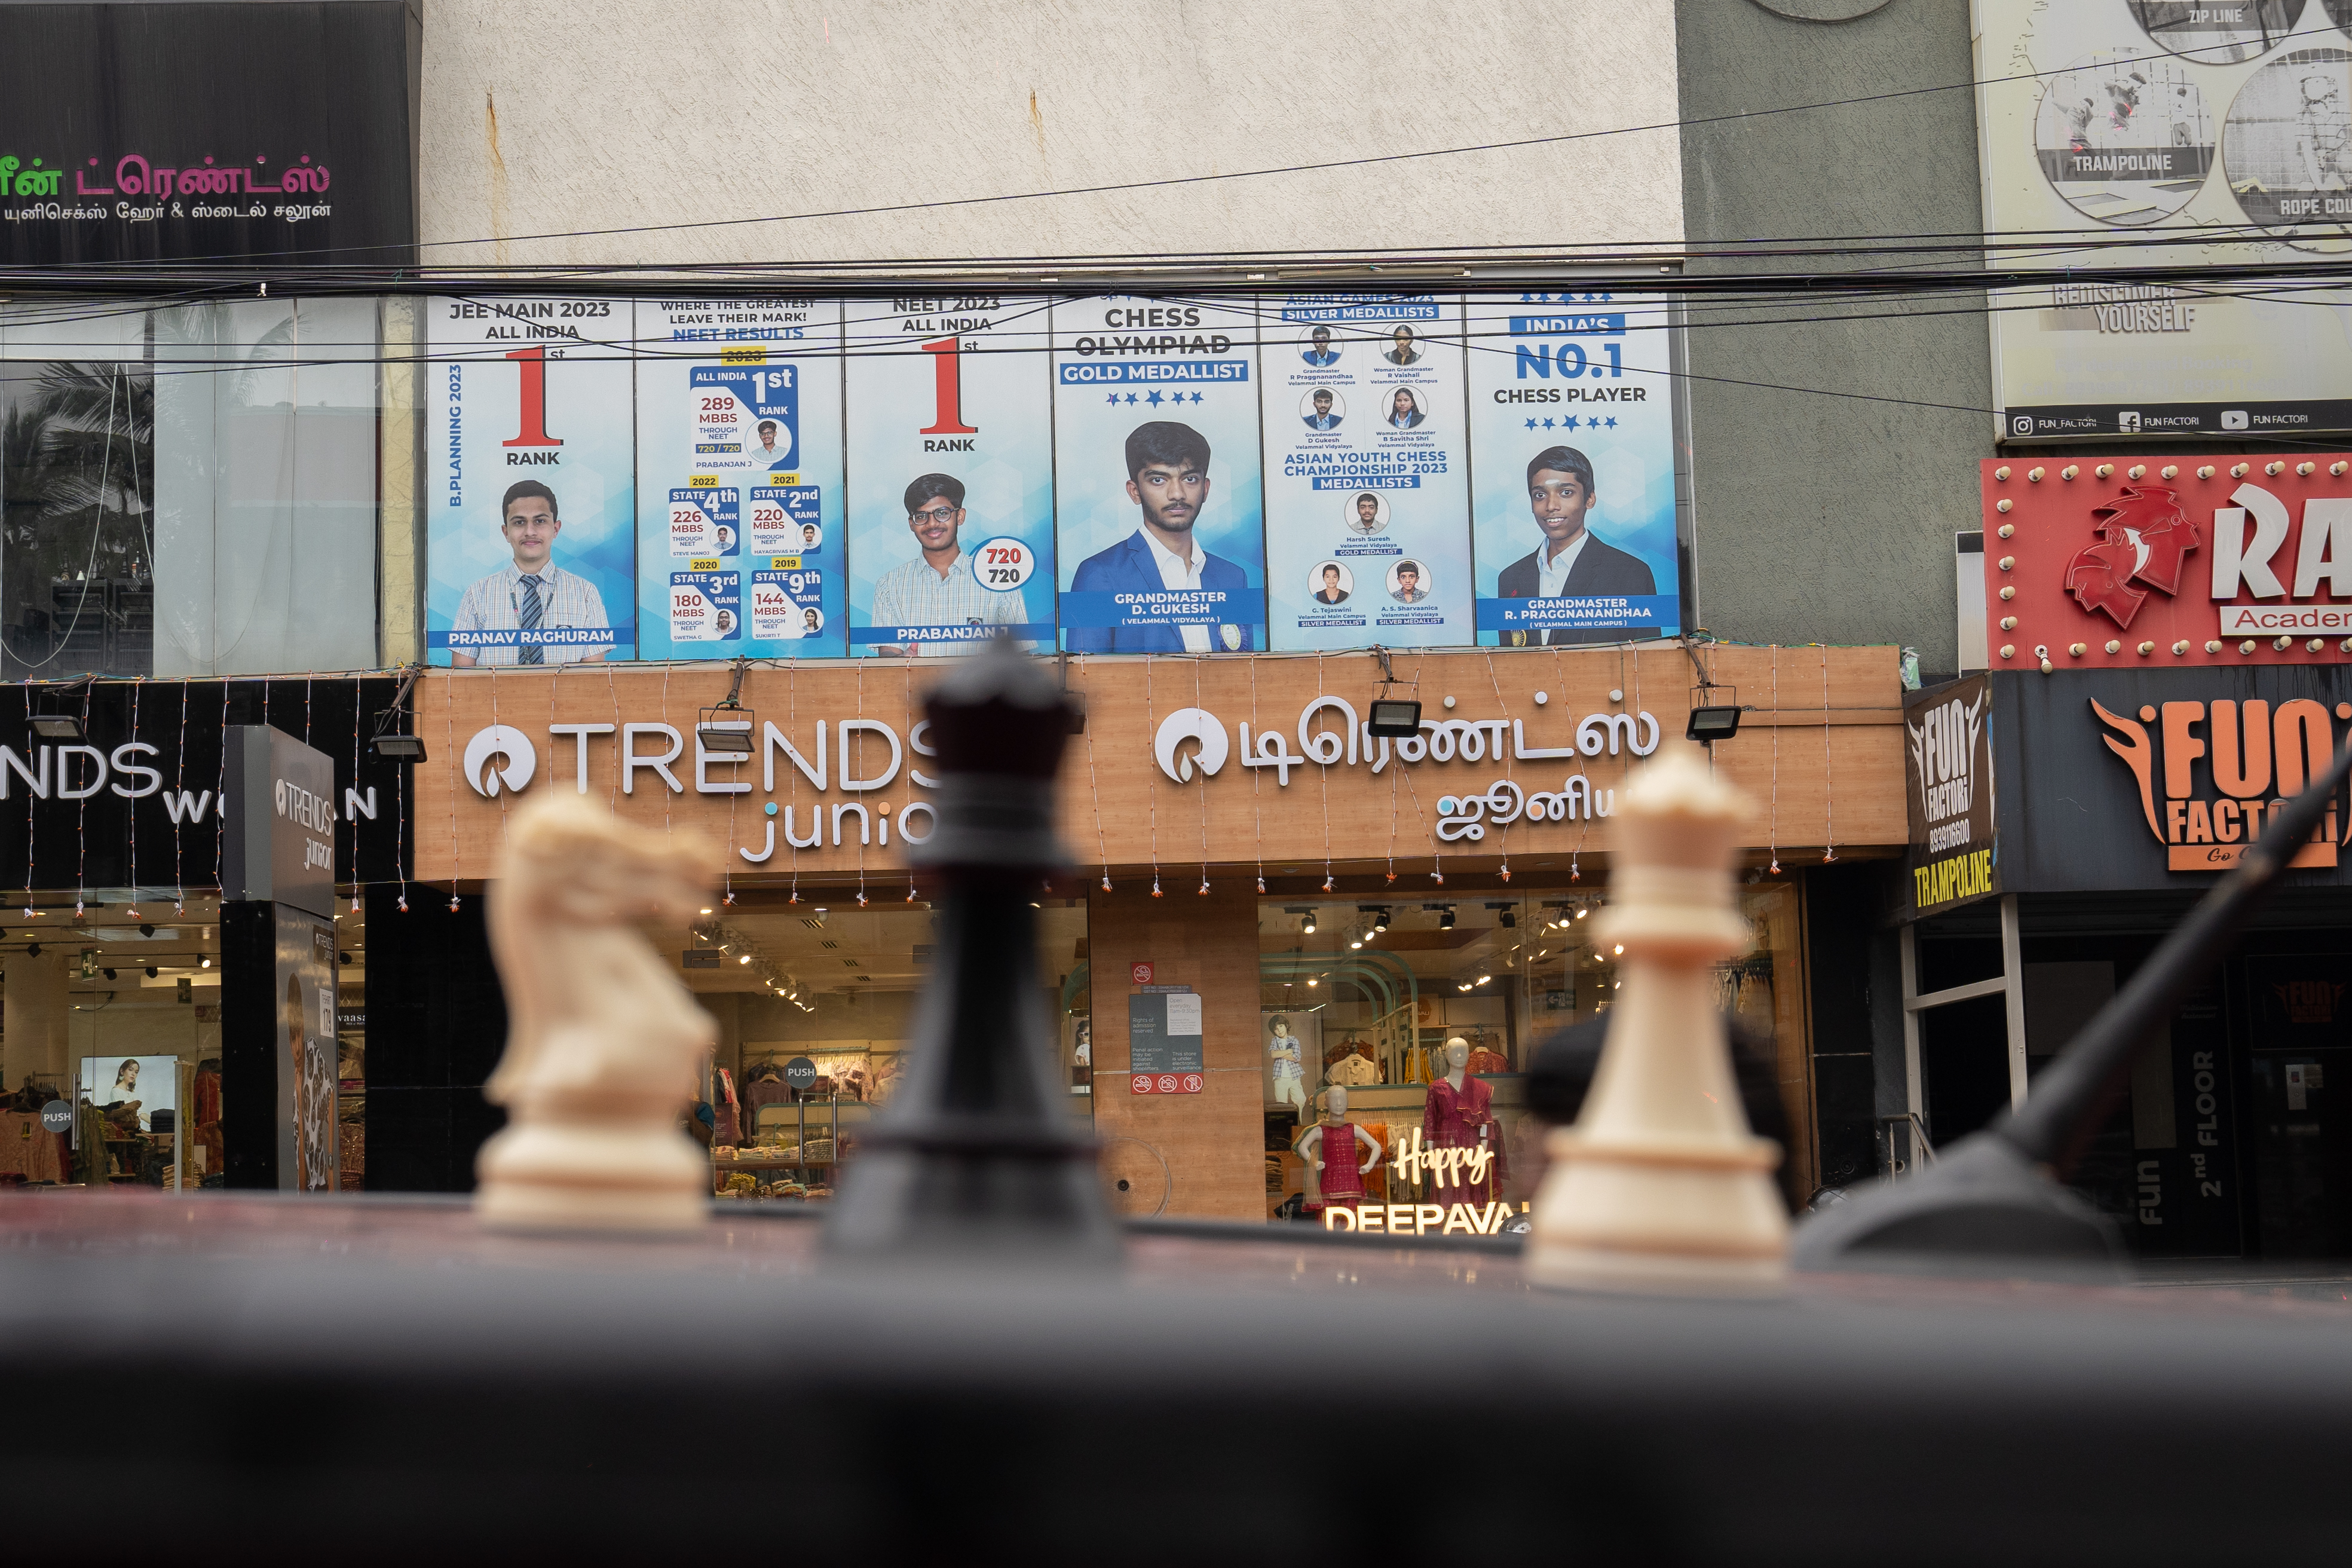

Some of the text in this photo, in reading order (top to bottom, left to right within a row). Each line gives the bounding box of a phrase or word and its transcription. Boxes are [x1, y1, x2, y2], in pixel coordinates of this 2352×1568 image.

[2189, 8, 2243, 24] ZIP LINE
[2074, 154, 2172, 172] TRAMPOLINE
[171, 201, 185, 219] &
[2280, 199, 2320, 215] ROPE
[449, 301, 611, 319] JEE MAIN 2023
[660, 299, 816, 311] WHERE THE GREATEST
[893, 297, 1001, 313] NEET 2023
[670, 311, 807, 324] LEAVE THEIR MARK!
[1105, 307, 1200, 328] CHESS
[1287, 307, 1435, 320] SILVER MEDALLISTS
[2096, 305, 2195, 333] YOURSELF
[485, 324, 580, 339] ALL INDIA
[902, 318, 993, 332] ALL INDIA
[1526, 317, 1610, 333] INDIA'S
[673, 326, 805, 341] NEET RESULTS
[1075, 335, 1232, 356] OLYMPIAD
[1516, 343, 1622, 379] NO.1
[696, 372, 716, 382] ALL
[717, 371, 747, 381] INDIA
[1064, 363, 1244, 381] GOLD MEDALLIST
[1493, 387, 1647, 404] CHESS PLAYER
[701, 396, 735, 411] 289
[759, 406, 789, 415] RANK
[699, 414, 738, 424] MBBS
[2038, 418, 2097, 429] FUN_FACTORI
[2144, 416, 2200, 427] FUN FACTORI
[2253, 414, 2308, 424] FUN FACTORI
[449, 364, 462, 507] B.PLANNING 2023
[924, 439, 976, 452] RANK
[507, 451, 561, 466] RANK
[1284, 451, 1447, 464] ASIAN YOUTH CHESS
[1284, 463, 1448, 476] CHAMPIONSHIP 2023
[692, 477, 716, 486] 2022
[1320, 477, 1413, 489] MEDALLISTS
[672, 489, 737, 513] STATE 4th
[754, 489, 818, 508] STATE 2nd
[672, 510, 702, 523] 226
[754, 509, 783, 521] 220
[795, 511, 819, 519] RANK
[672, 525, 703, 533] MBBS
[753, 521, 785, 529] MBBS
[986, 548, 1021, 564] 720
[755, 571, 821, 594] STATE 9th
[988, 568, 1020, 583] 720
[674, 574, 738, 594] STATE 3rd
[675, 595, 702, 607] 180
[755, 593, 784, 605] 144
[1114, 592, 1227, 604] GRANDMASTER
[1527, 598, 1628, 610] GRANDMASTER
[673, 608, 705, 617] MBBS
[754, 607, 786, 615] MBBS
[1132, 604, 1210, 615] D. GUKESH
[1505, 608, 1652, 620] R. PRAGGNANANDHAA
[449, 629, 615, 645] PRANAV RAGHURAM
[897, 627, 996, 640] PRABANJAN
[0, 742, 163, 801] NDS
[286, 782, 332, 837] TRENDS
[2166, 798, 2338, 844] FACTi
[739, 801, 940, 863] junio
[1930, 818, 1970, 854] 8939116600
[304, 836, 332, 871] junior
[1914, 849, 1992, 908] TRAMPOLINE
[318, 933, 333, 951] TRENDS
[323, 1007, 332, 1033] 179
[2192, 1050, 2219, 1147] FLOOR
[43, 1113, 72, 1122] PUSH
[1394, 1126, 1494, 1189] Happy
[1325, 1201, 1530, 1236] DEEPAVA
